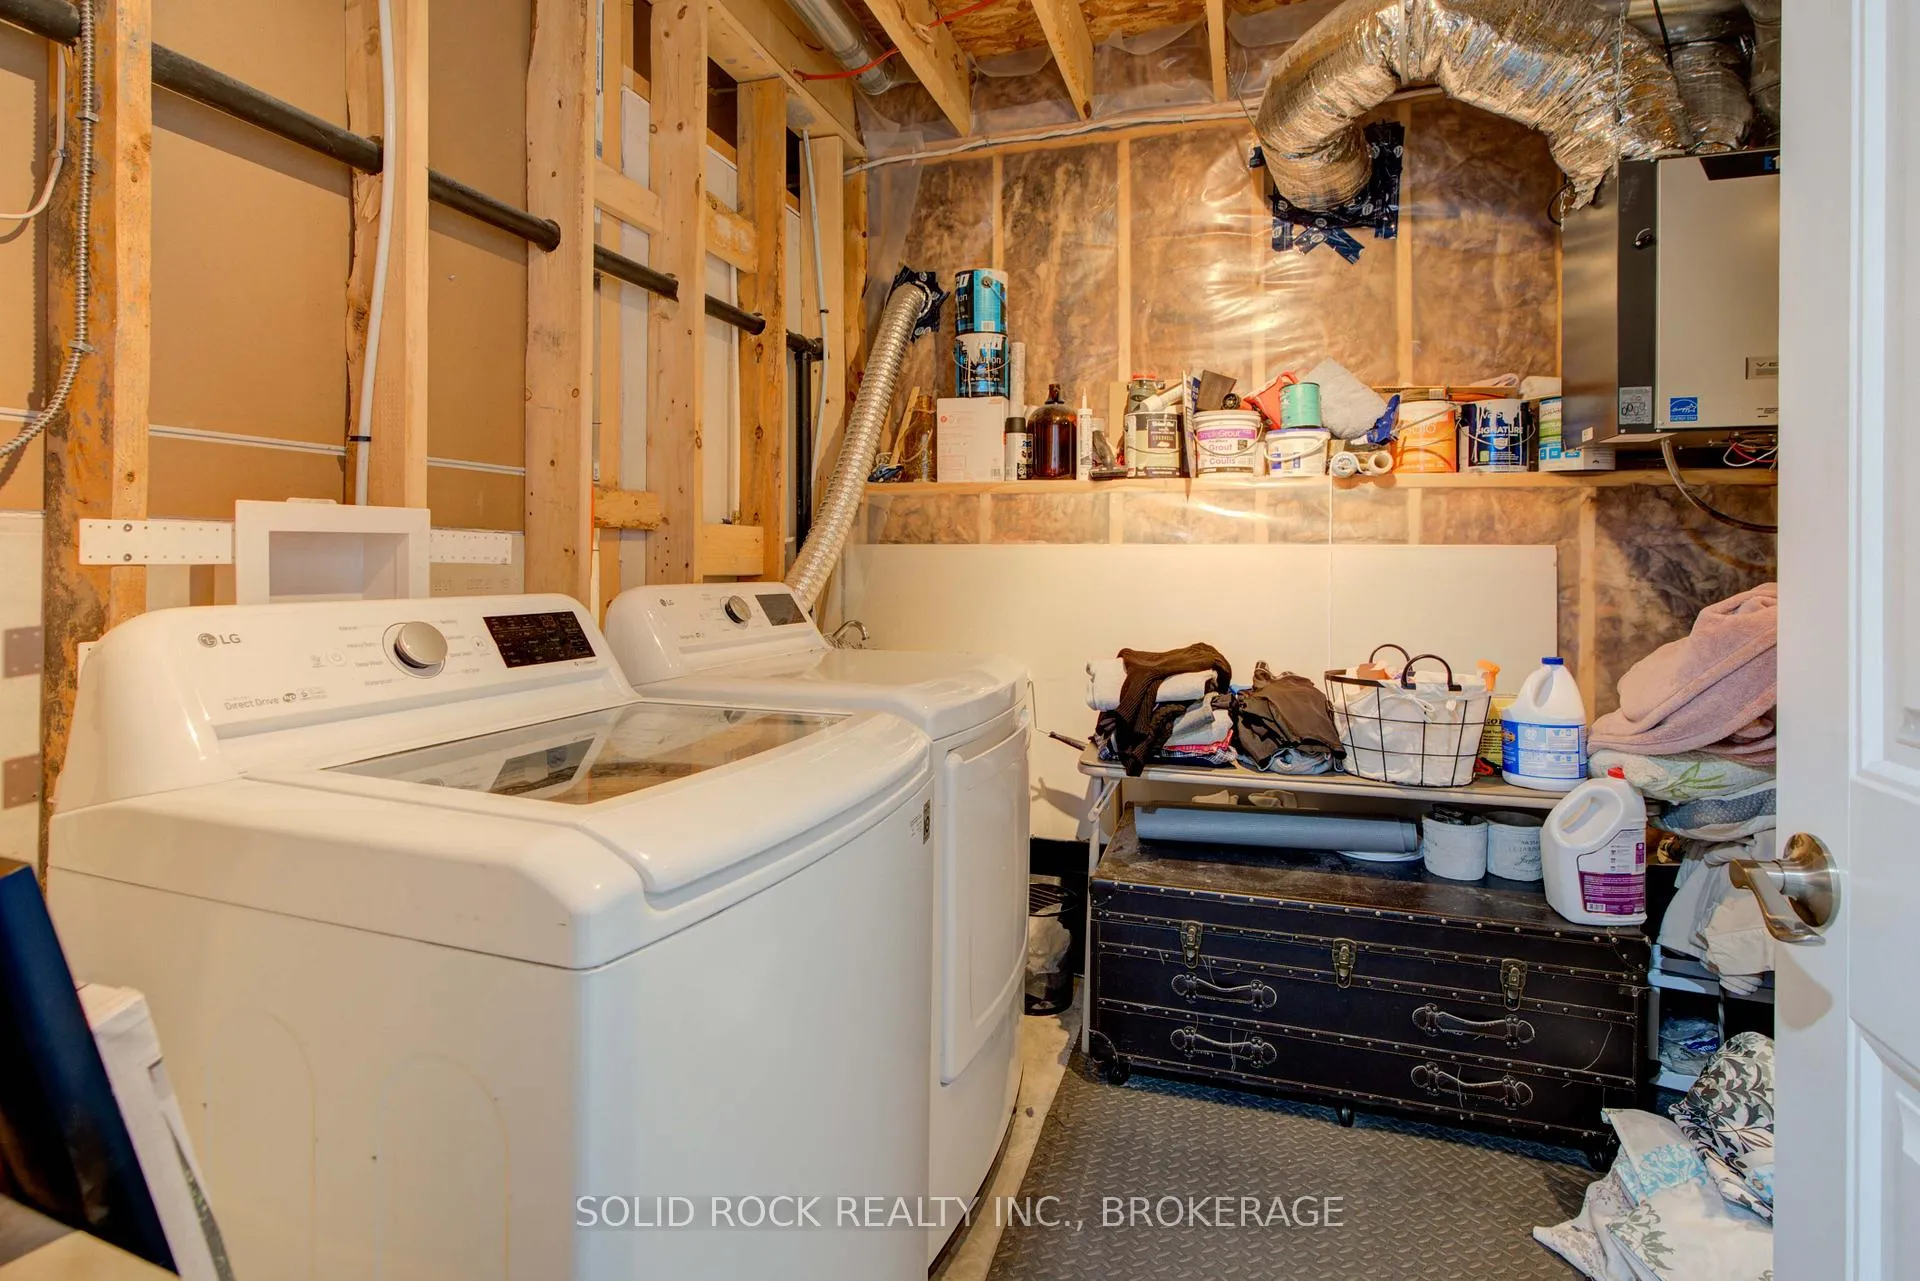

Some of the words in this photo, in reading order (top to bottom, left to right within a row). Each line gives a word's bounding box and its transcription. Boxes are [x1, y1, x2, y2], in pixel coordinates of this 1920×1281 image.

[1209, 456, 1236, 465] Coulis
[219, 633, 241, 645] LG
[224, 699, 254, 711] Direct
[254, 697, 280, 708] Drive
